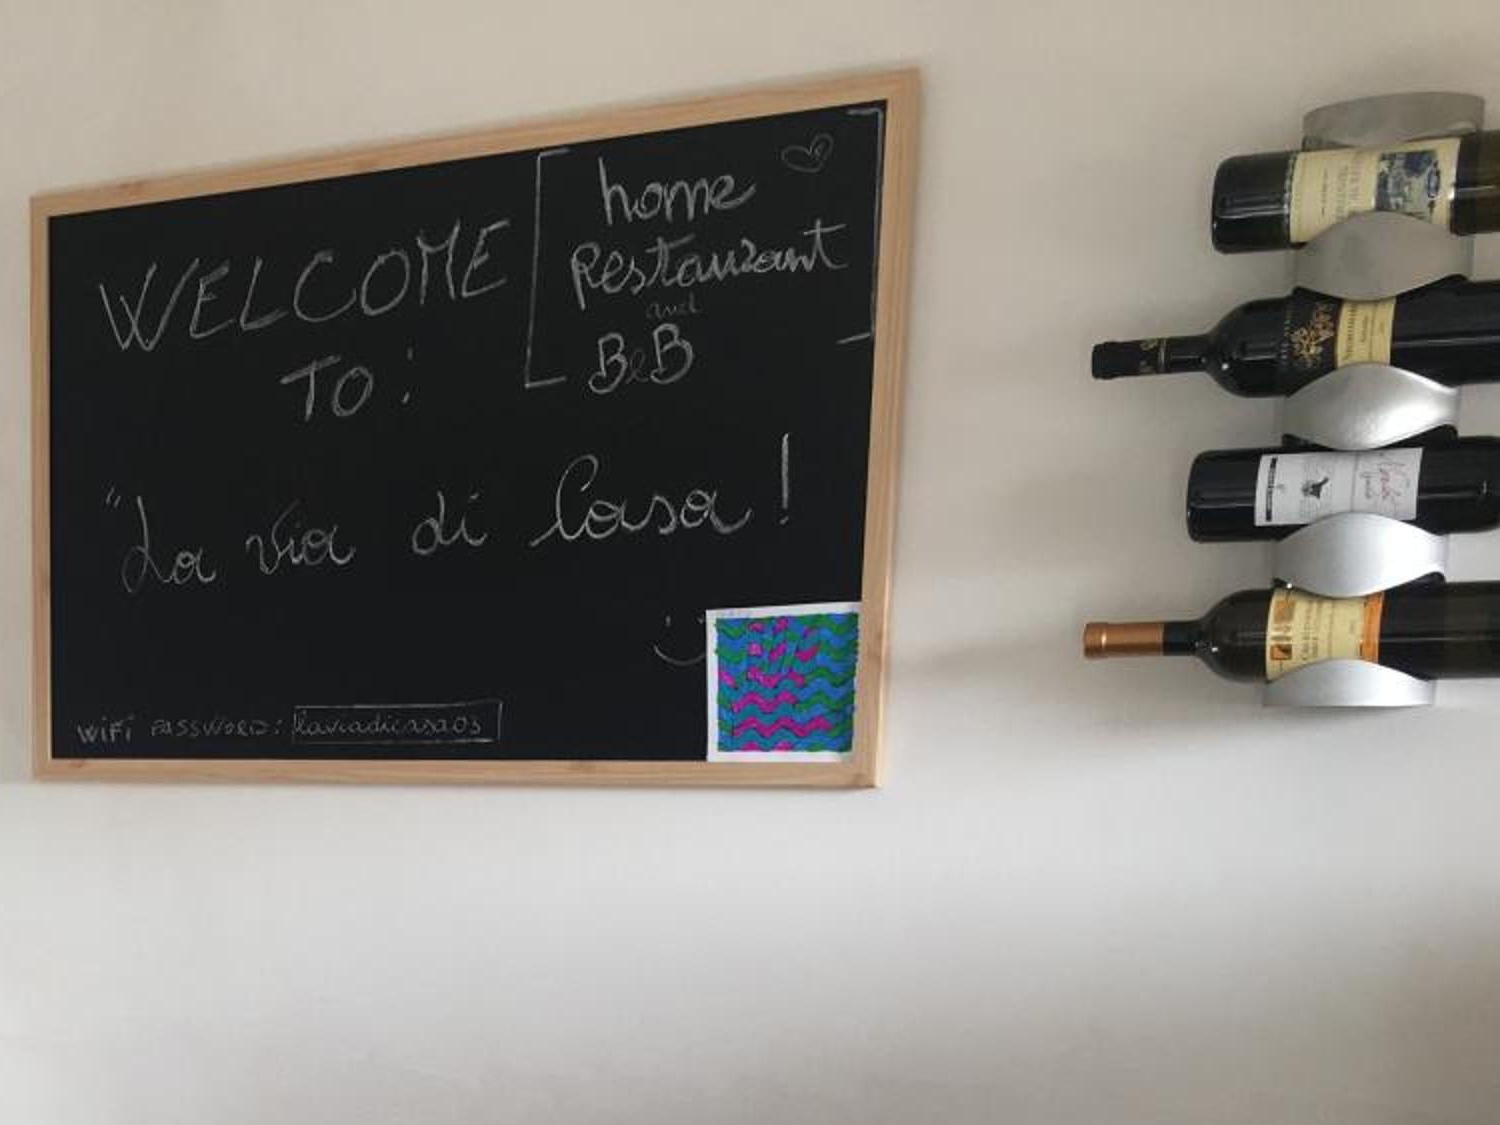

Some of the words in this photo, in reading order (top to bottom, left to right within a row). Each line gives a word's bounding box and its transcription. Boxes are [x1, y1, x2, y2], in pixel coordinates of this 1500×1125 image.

[598, 155, 757, 226] home
[99, 216, 511, 352] WELCOME
[570, 218, 848, 311] Restaurant
[412, 490, 488, 555] di
